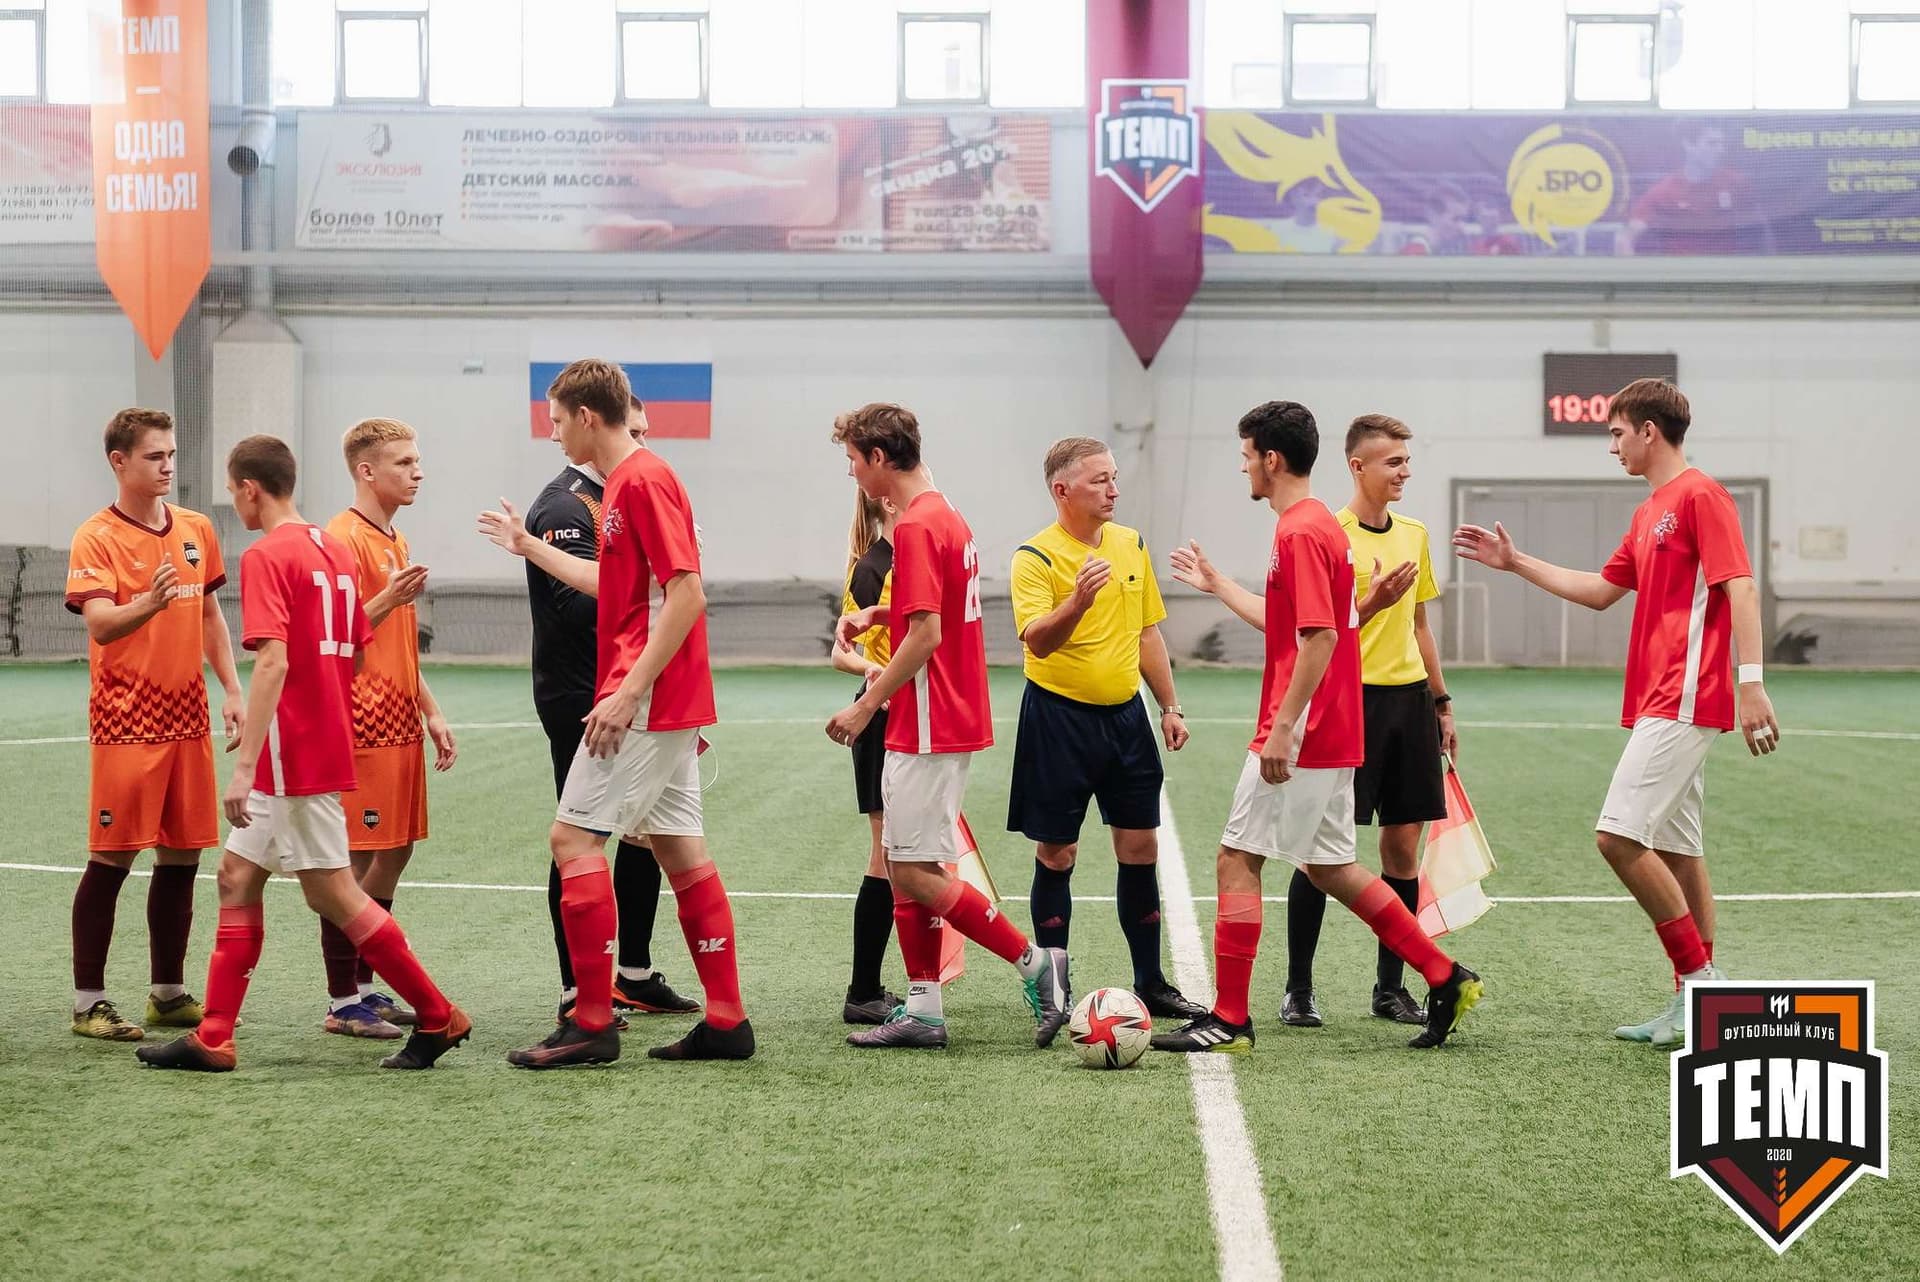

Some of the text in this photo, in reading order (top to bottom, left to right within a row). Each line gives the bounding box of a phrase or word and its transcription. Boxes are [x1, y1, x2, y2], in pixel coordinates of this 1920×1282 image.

[114, 120, 185, 165] ОДНА
[1105, 116, 1189, 162] ТЕМП
[106, 172, 197, 213] СЕМЬЯ!
[462, 171, 547, 188] ДЕТСКИЙ
[309, 207, 375, 226] более
[1548, 394, 1615, 423] 19:0
[554, 528, 581, 540] ПСБ
[311, 570, 356, 658] 11
[697, 936, 728, 954] 2K
